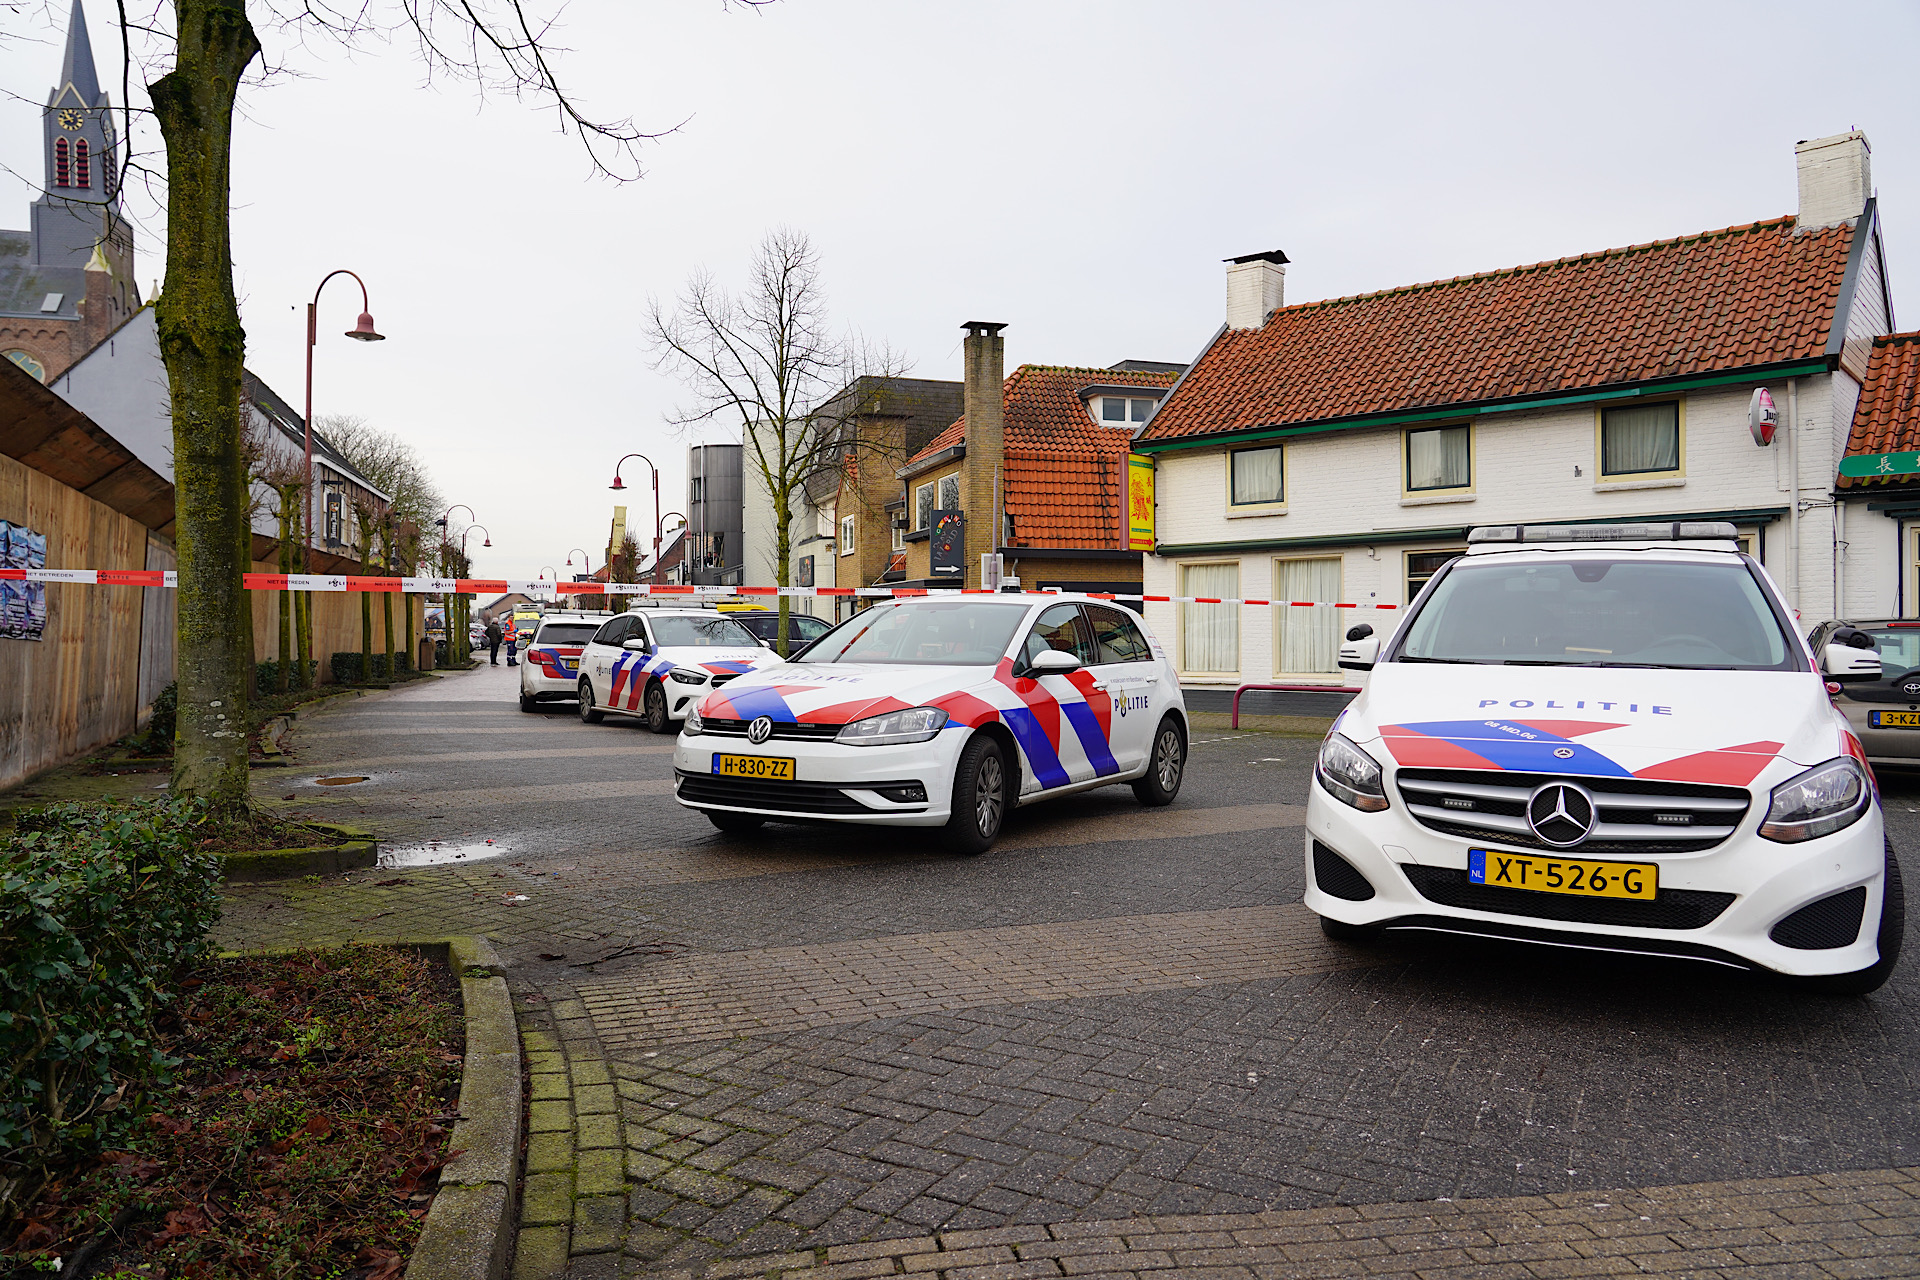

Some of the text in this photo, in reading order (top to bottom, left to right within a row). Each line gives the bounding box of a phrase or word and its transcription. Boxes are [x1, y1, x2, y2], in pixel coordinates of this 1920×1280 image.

[1763, 409, 1776, 423] Jup
[1114, 695, 1149, 717] POLITIE
[1478, 699, 1672, 716] POLITIE
[1886, 713, 1920, 725] 3-KZ
[1484, 720, 1538, 740] 08 MD.06
[724, 757, 788, 777] H-830-ZZ
[1471, 857, 1643, 894] NL XT-526-G
